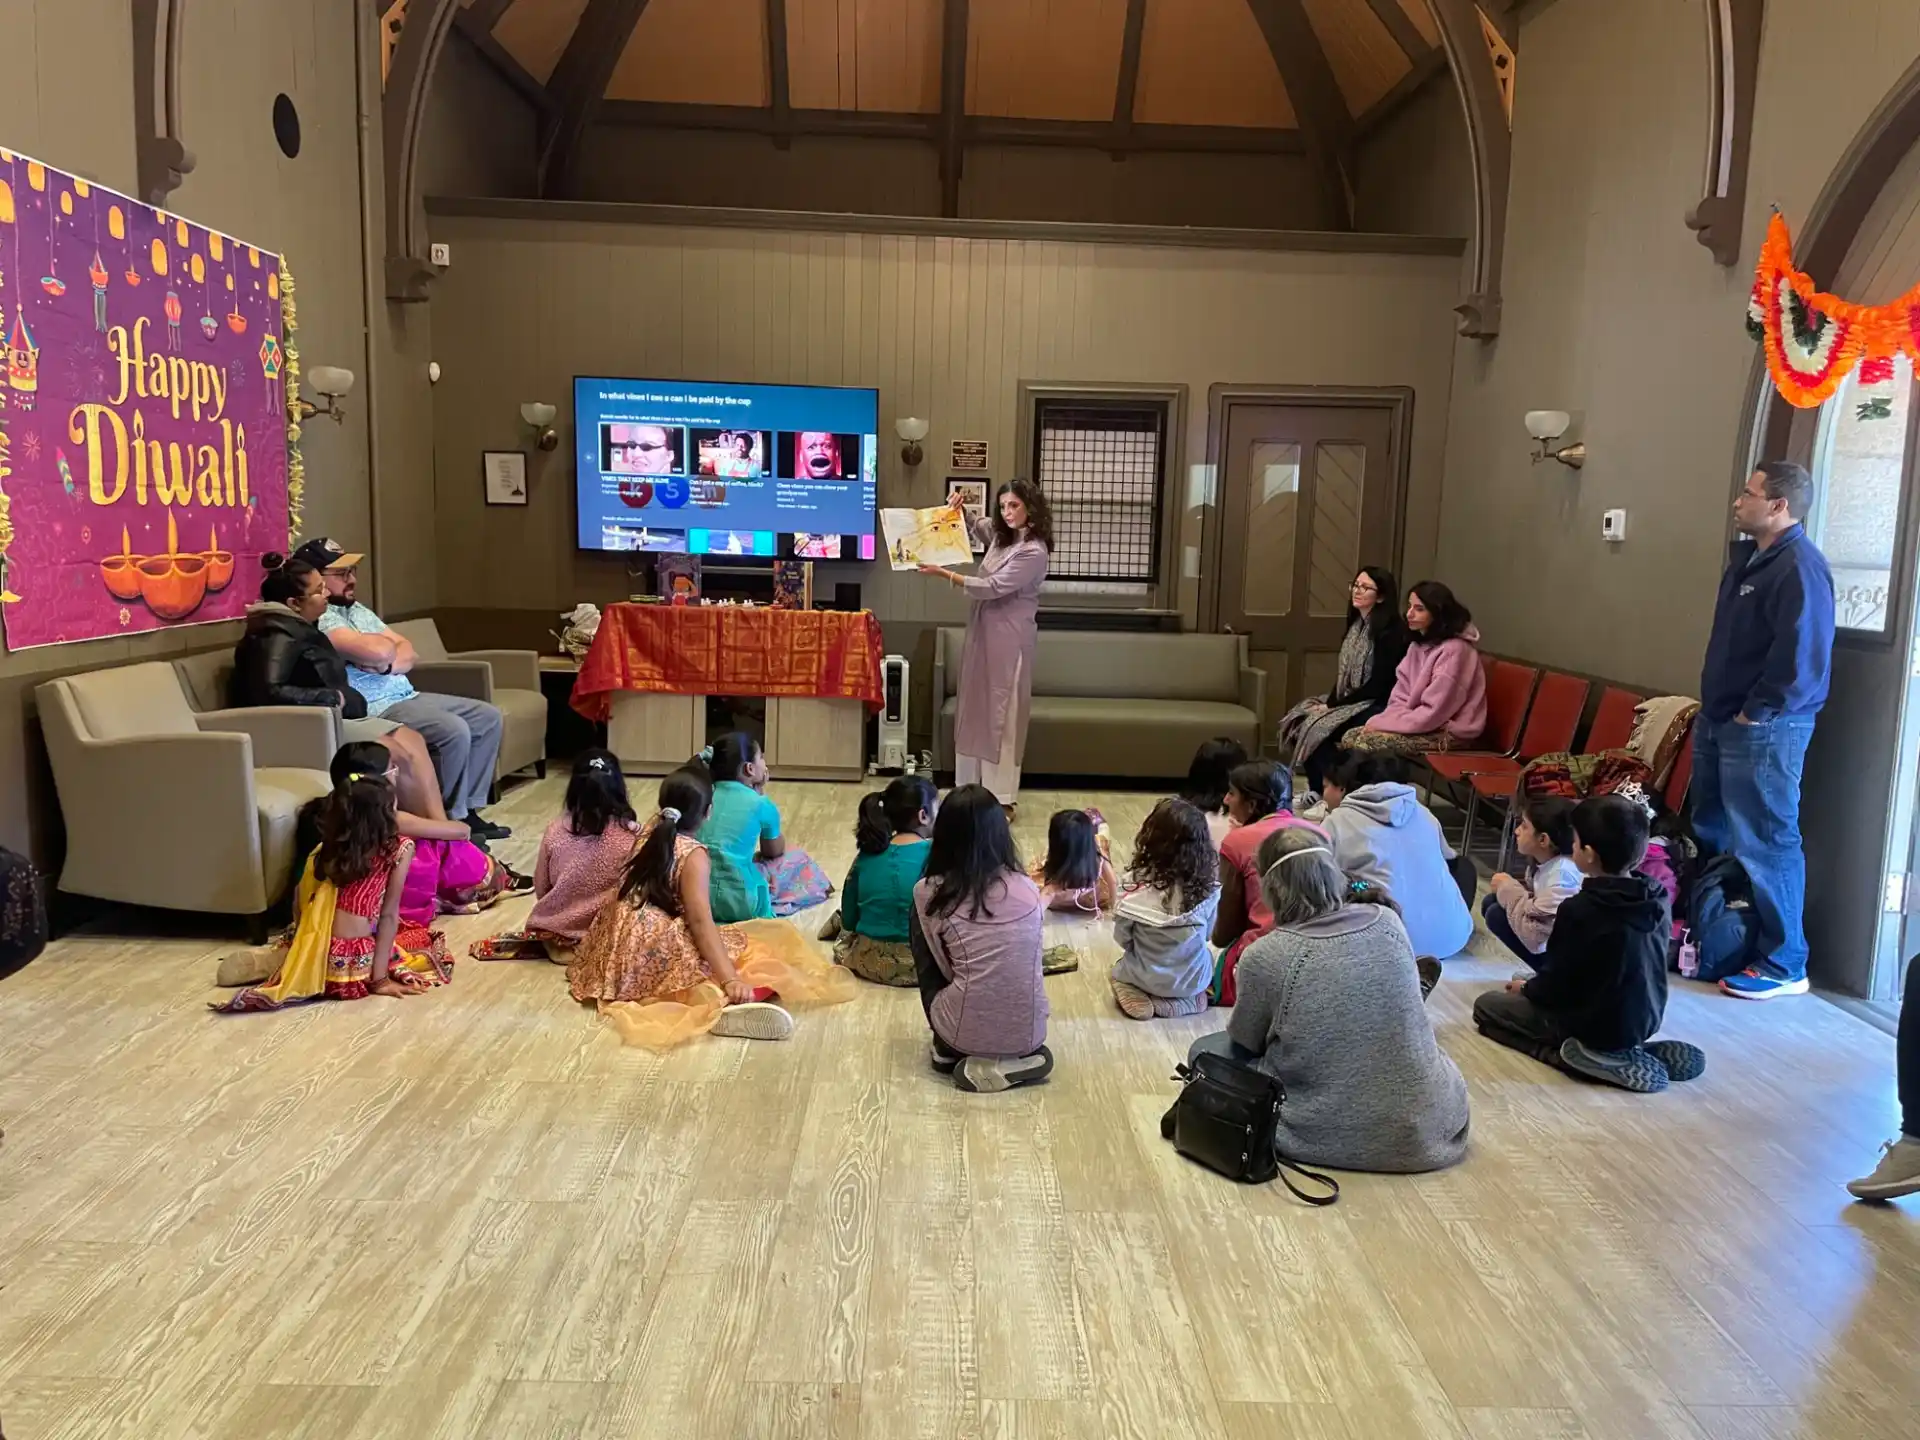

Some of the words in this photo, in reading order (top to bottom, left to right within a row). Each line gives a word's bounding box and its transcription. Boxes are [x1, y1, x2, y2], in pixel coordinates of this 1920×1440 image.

[107, 316, 227, 422] Happy
[599, 391, 608, 400] In
[608, 392, 626, 400] what
[688, 395, 698, 403] be
[698, 395, 714, 405] paid
[715, 396, 724, 406] by
[725, 396, 737, 405] the
[737, 398, 752, 407] cup
[69, 403, 250, 507] Diwali
